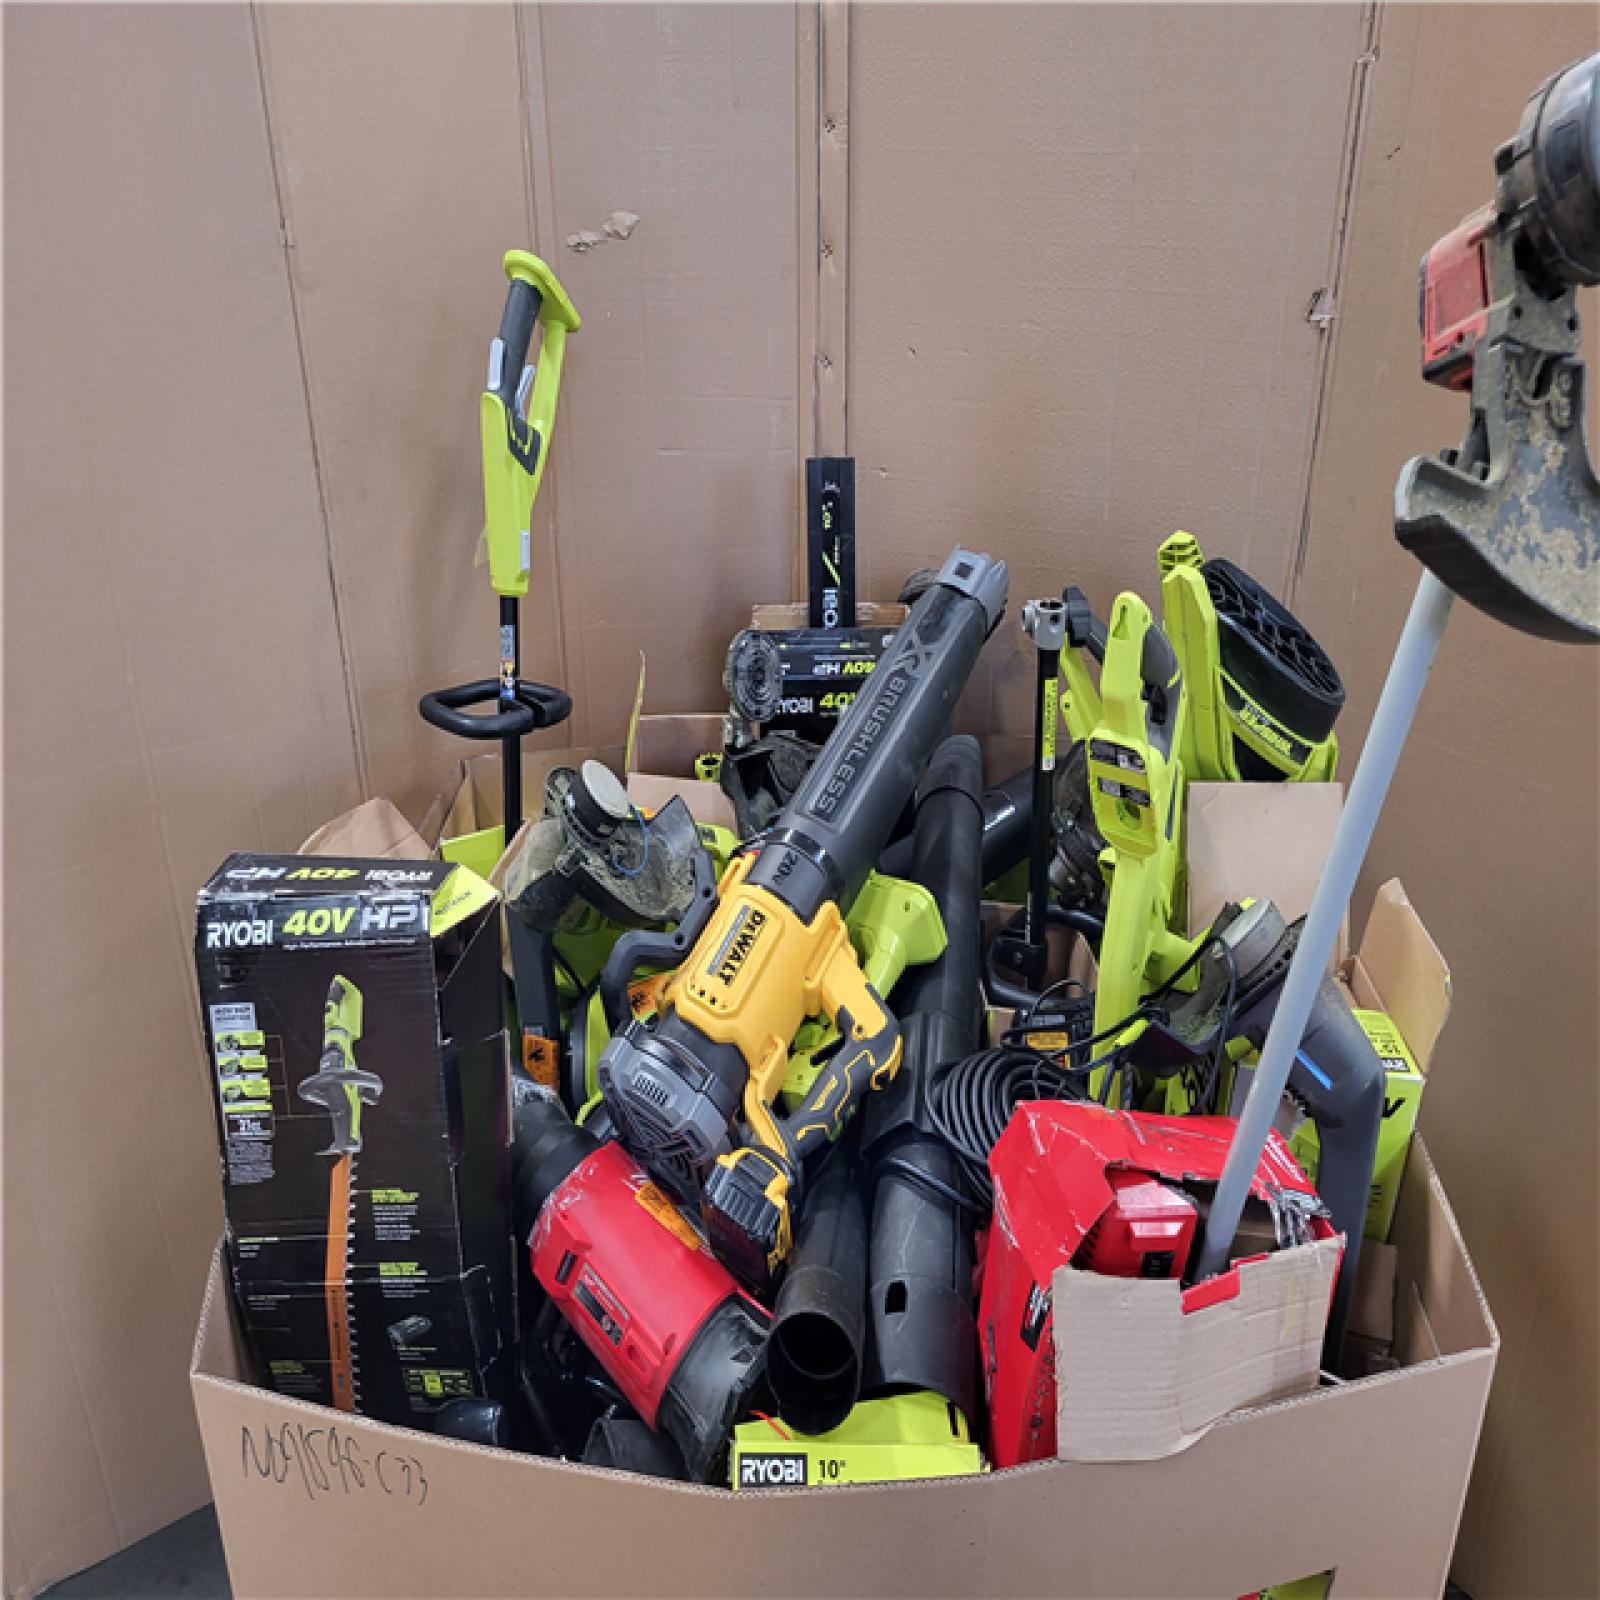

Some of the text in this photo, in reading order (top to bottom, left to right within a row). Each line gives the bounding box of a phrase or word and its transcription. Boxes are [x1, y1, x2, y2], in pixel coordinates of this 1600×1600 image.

[817, 676, 908, 814] BRUSHLESS
[206, 920, 273, 948] RYOBI
[282, 906, 357, 936] 40V
[718, 908, 767, 987] DEWALT
[740, 1458, 804, 1483] RYOBI
